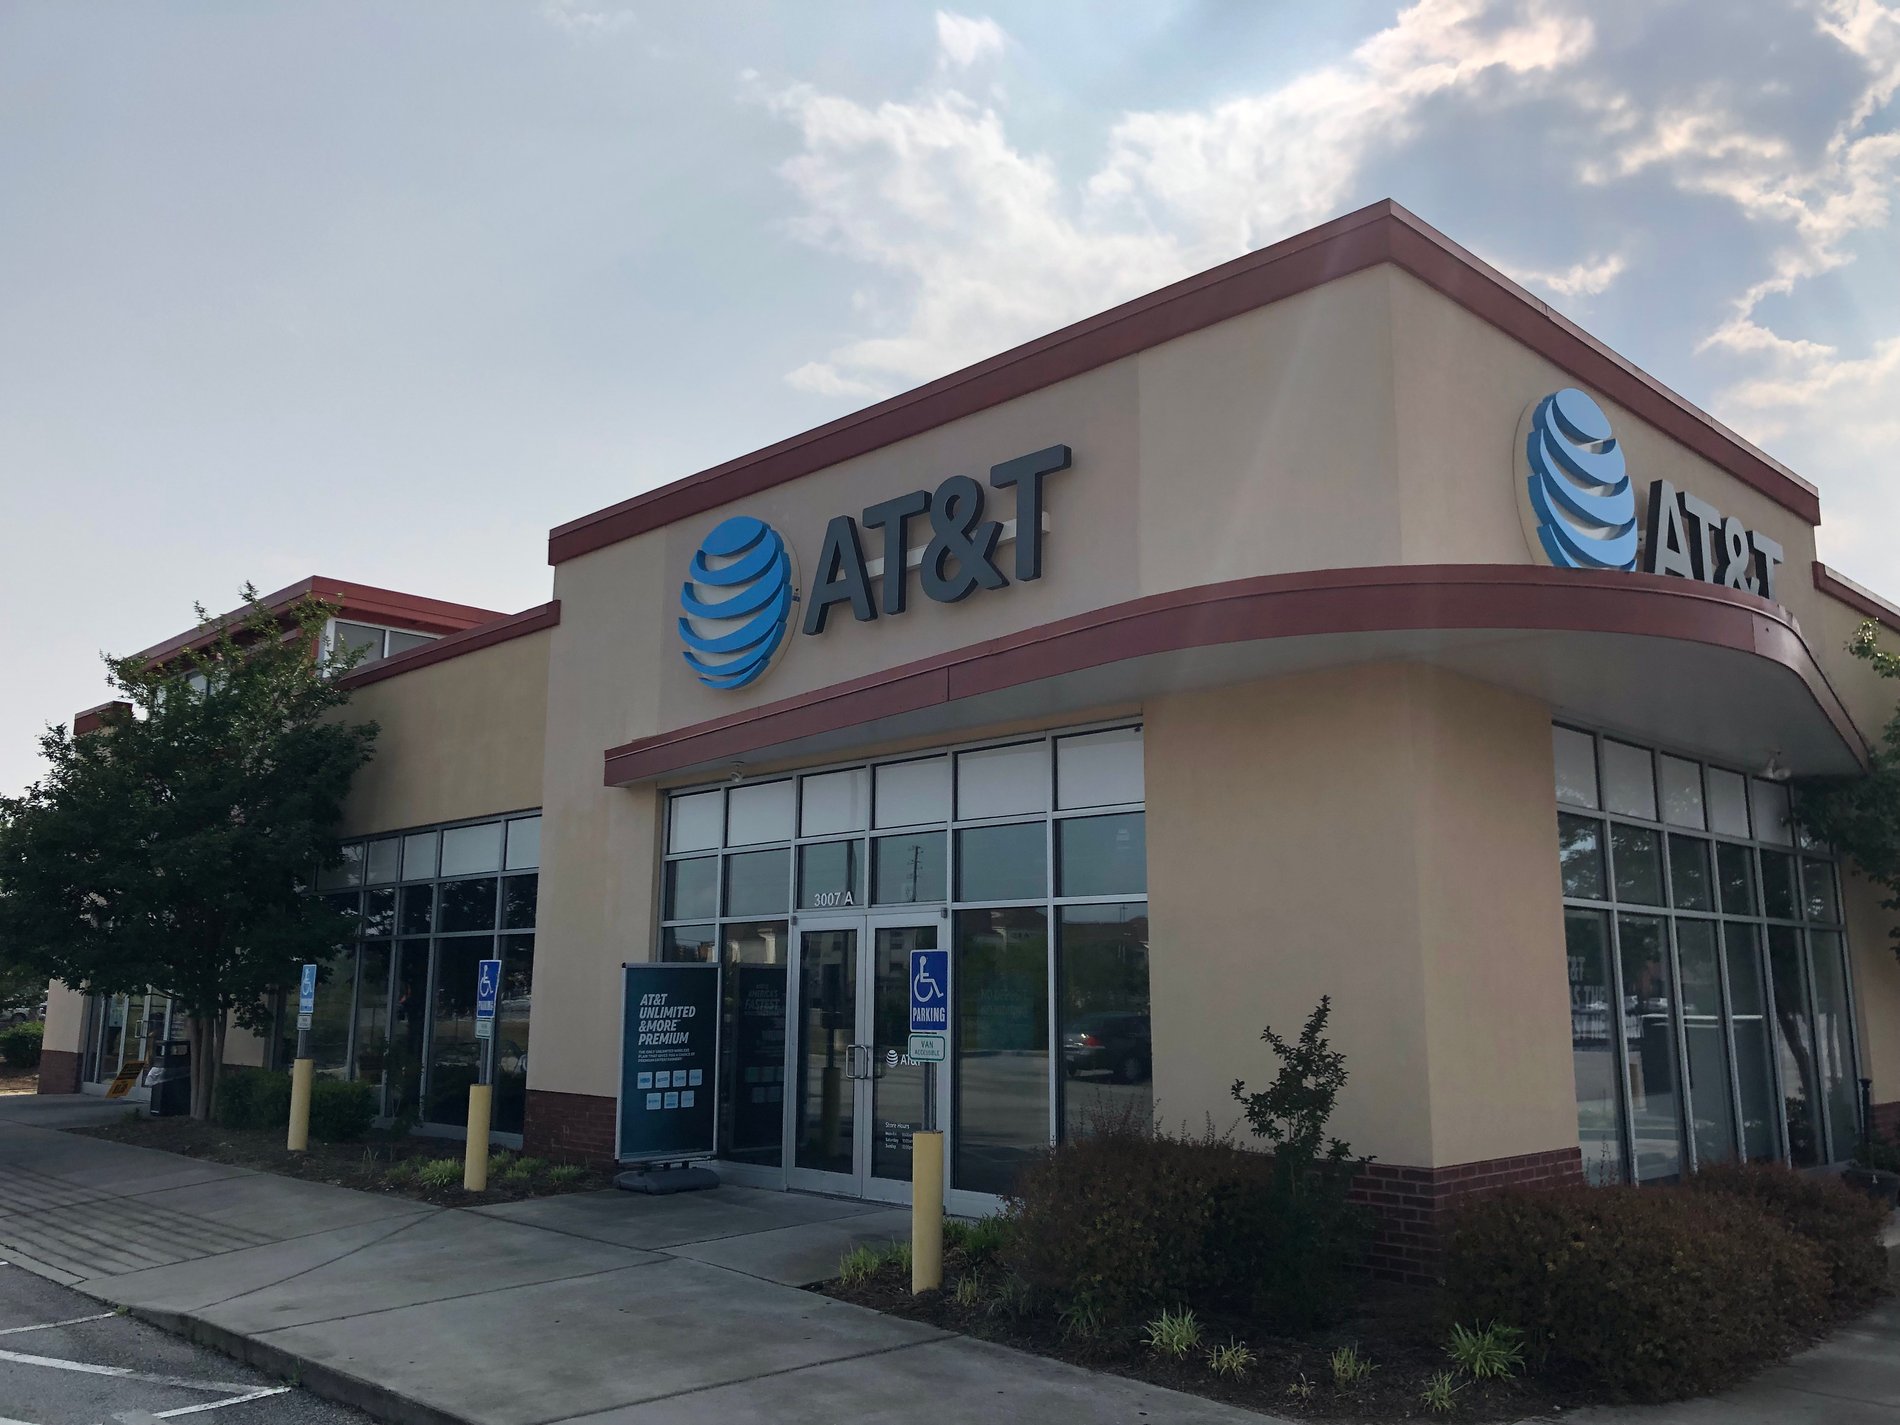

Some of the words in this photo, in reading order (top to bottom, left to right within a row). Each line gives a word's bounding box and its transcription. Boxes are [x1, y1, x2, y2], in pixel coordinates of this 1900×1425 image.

[802, 444, 1072, 636] AT&T
[1643, 479, 1784, 601] AT&T
[814, 892, 841, 907] 3007
[844, 891, 854, 905] A
[640, 994, 667, 1006] AT&T
[639, 1006, 695, 1018] UNLIMITED
[912, 1007, 946, 1023] PARKING
[638, 1032, 689, 1045] PREMIUM
[920, 1040, 934, 1049] VAN
[885, 1121, 897, 1129] Store
[897, 1121, 910, 1129] Hours
